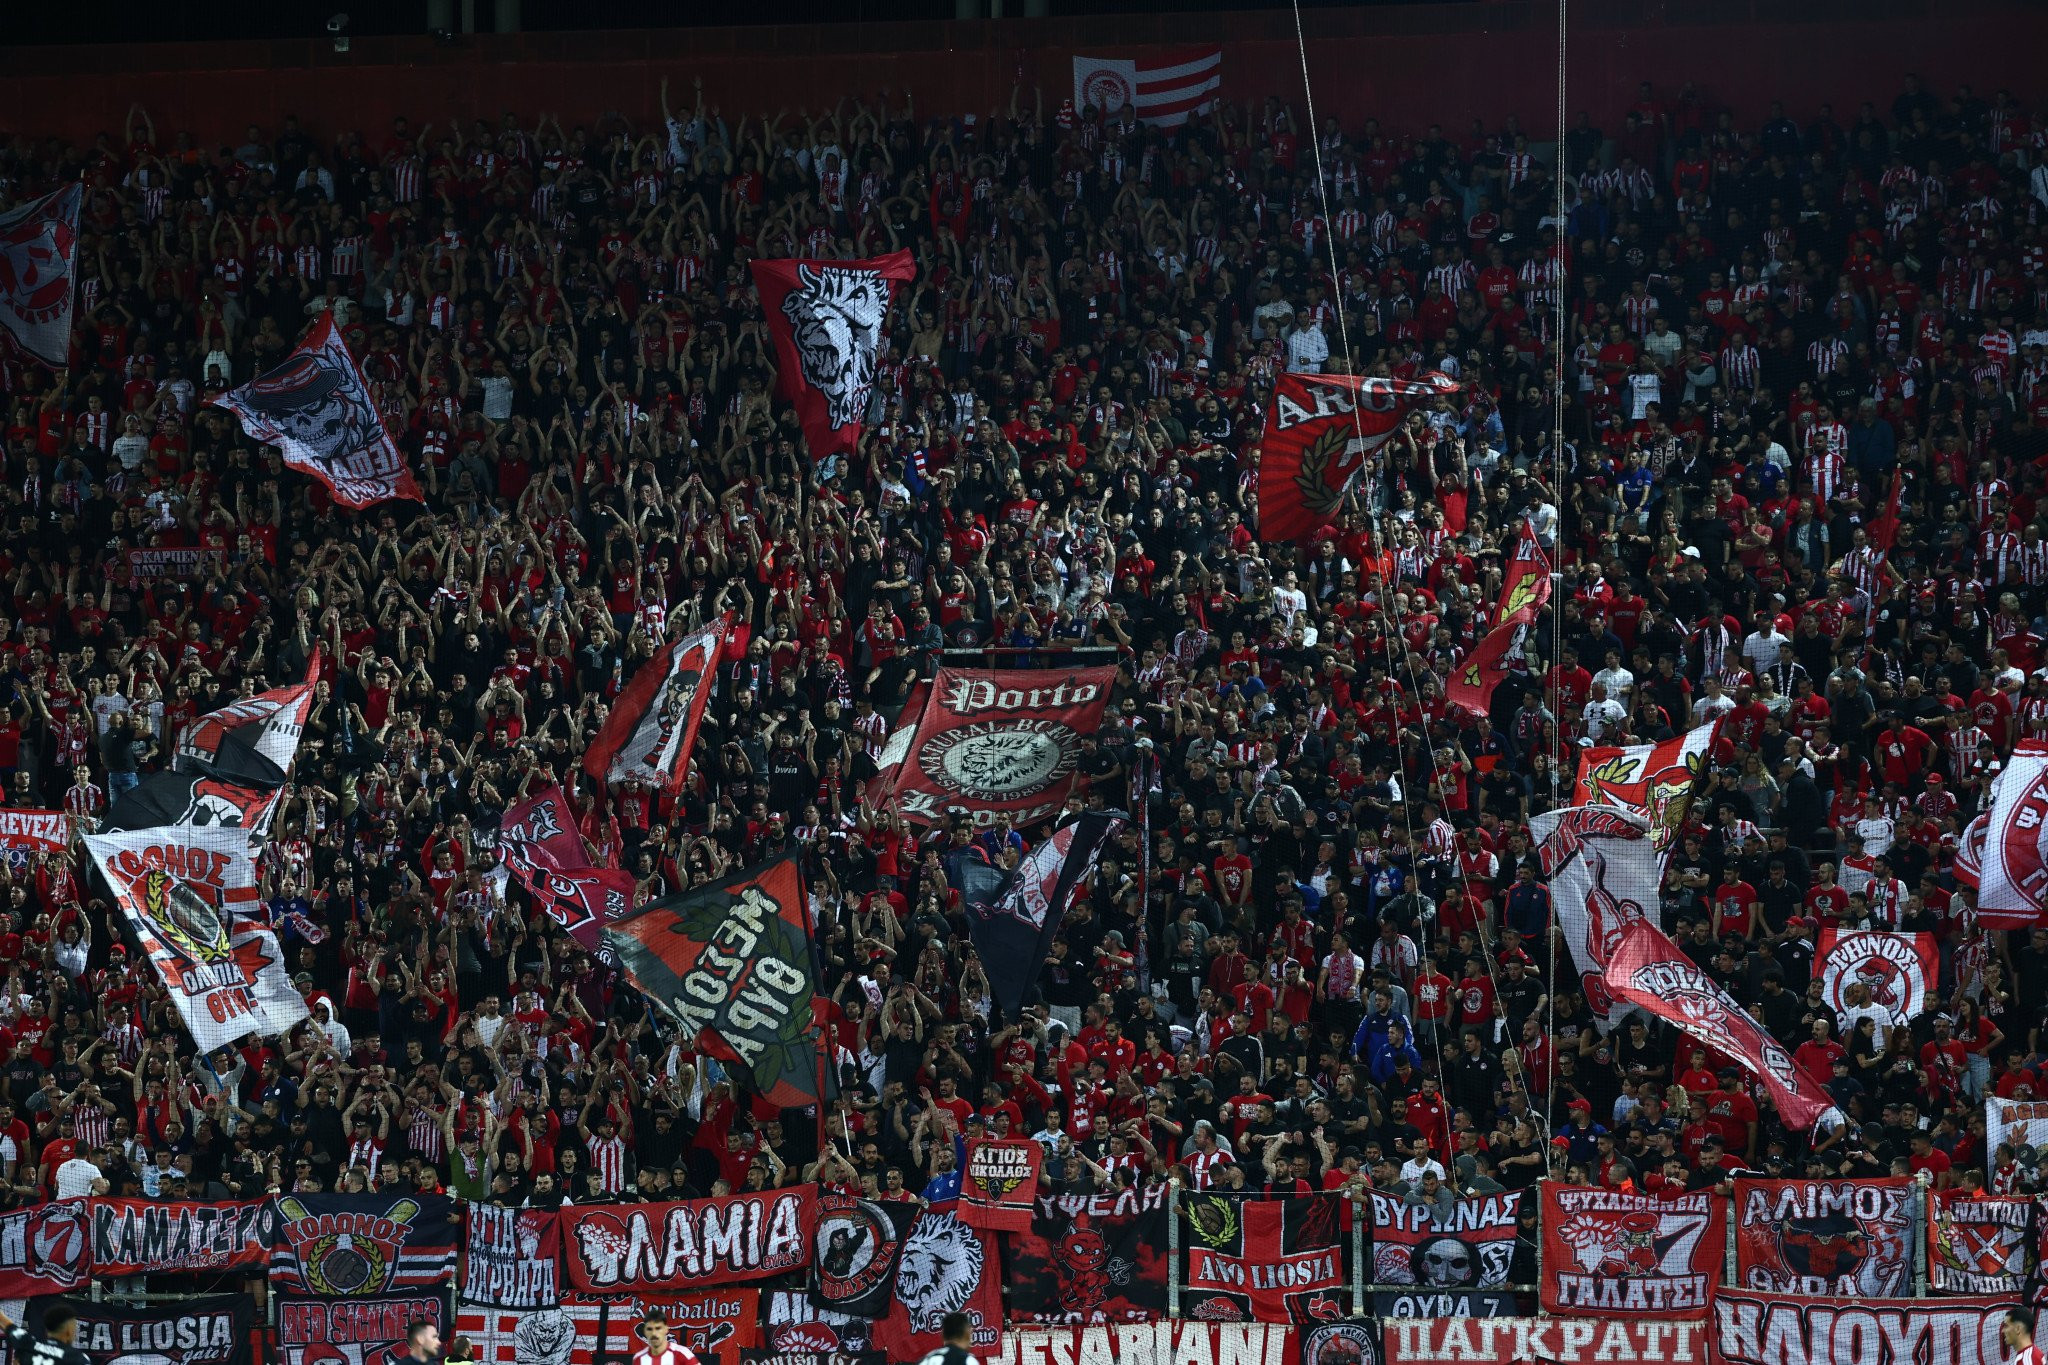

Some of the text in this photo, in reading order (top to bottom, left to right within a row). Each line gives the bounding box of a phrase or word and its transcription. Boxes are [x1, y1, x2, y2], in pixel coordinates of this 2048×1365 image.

[943, 677, 1098, 713] Porto
[922, 721, 1003, 775] NATURAL
[775, 764, 798, 775] bwin
[1827, 934, 1918, 972] ΤΗΝΟΣ
[970, 1165, 1032, 1178] ΝΙΚΟΛΑΟΣ
[973, 1149, 1028, 1164] ΑΓΙΟΣ
[1033, 1181, 1167, 1220] ΥΨΕΛΗ
[1371, 1192, 1522, 1233] ΒΥΡΩΝΑΣ
[1742, 1183, 1911, 1228] ΑΛΙΜΟΣ
[94, 1203, 273, 1265] ΚΑΜΑΤΕΡΟ
[282, 1212, 413, 1246] ΚΟΛΩΝΟΣ
[623, 1195, 803, 1281] ΛΑΜΙΑ
[763, 1249, 803, 1269] ΘΥΡΑ 7
[1250, 1254, 1335, 1290] LIOSIA
[463, 1251, 556, 1307] ΒΑΡΒΑΡΑ
[1559, 1274, 1707, 1309] ΓΑΛΑΤΣΙ
[283, 1304, 327, 1343] RED
[1392, 1296, 1471, 1318] ΘΥΡΑ
[121, 1315, 233, 1351] LIOSIA
[1396, 1319, 1695, 1362] ΠΑΓΚΡΑΤΙ
[181, 1346, 221, 1365] gate
